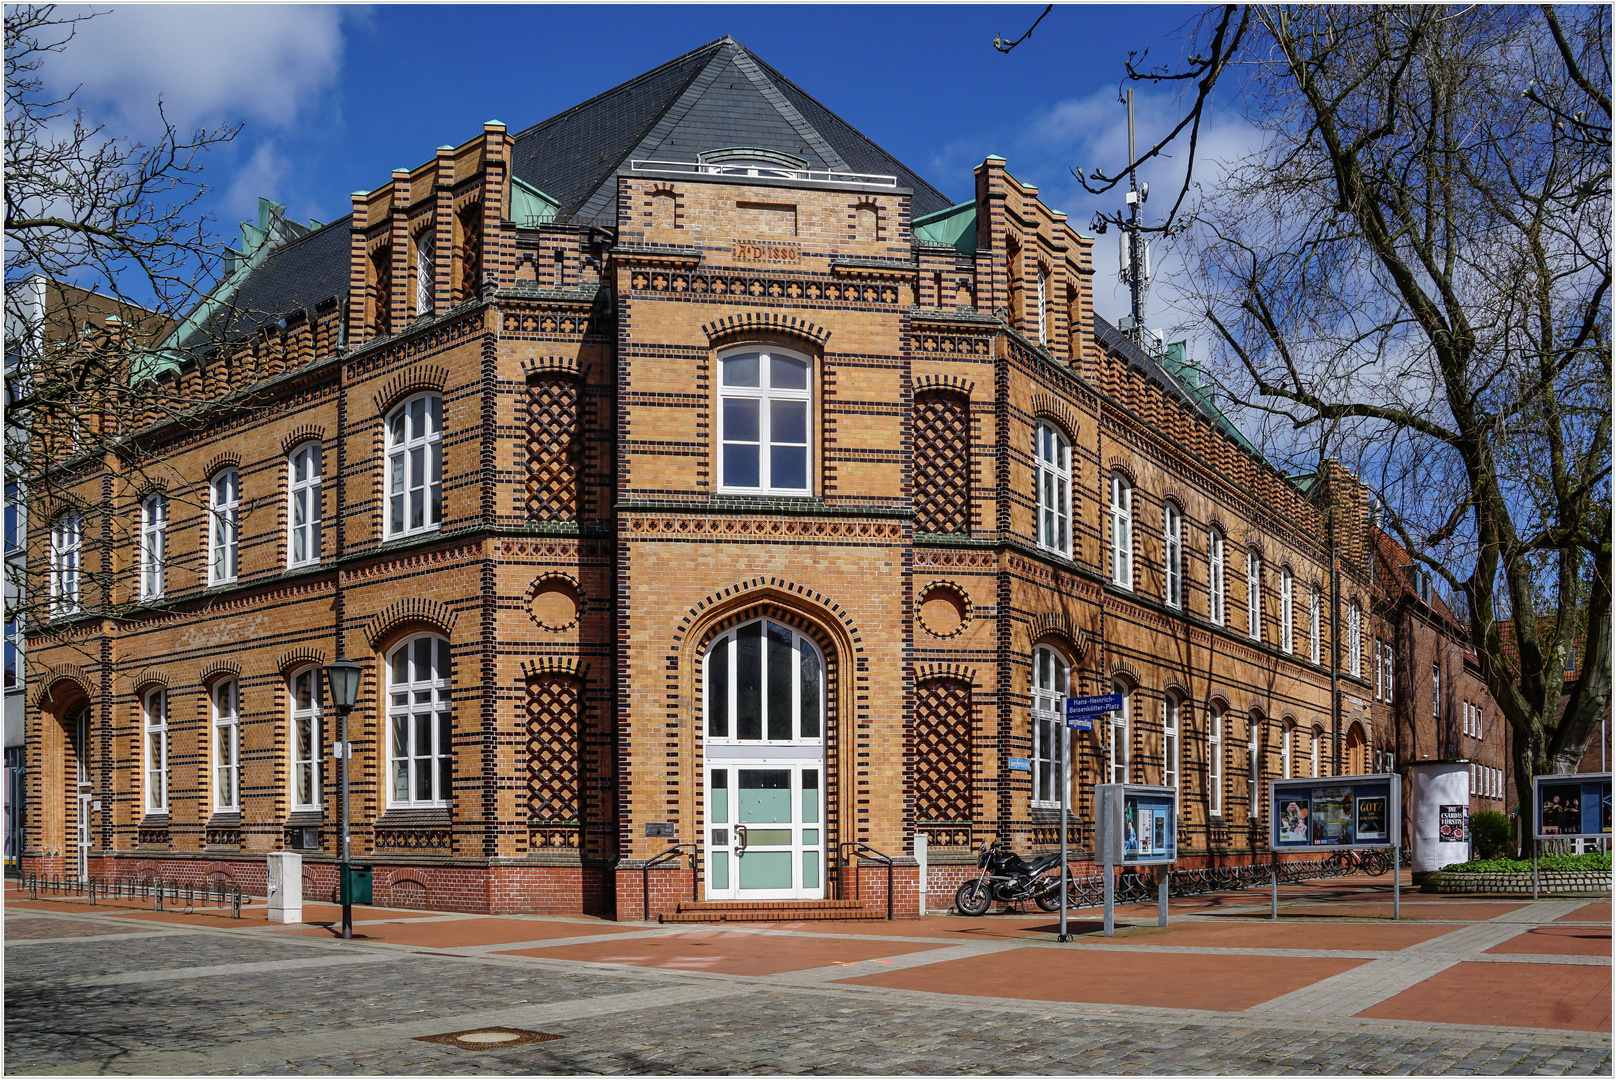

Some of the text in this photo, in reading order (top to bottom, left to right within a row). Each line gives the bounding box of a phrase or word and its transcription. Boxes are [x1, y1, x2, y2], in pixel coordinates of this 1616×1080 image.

[768, 247, 796, 261] 1880
[1073, 696, 1115, 706] Hans-Heinrich-
[1069, 703, 1120, 713] Beisenkötter-Platz
